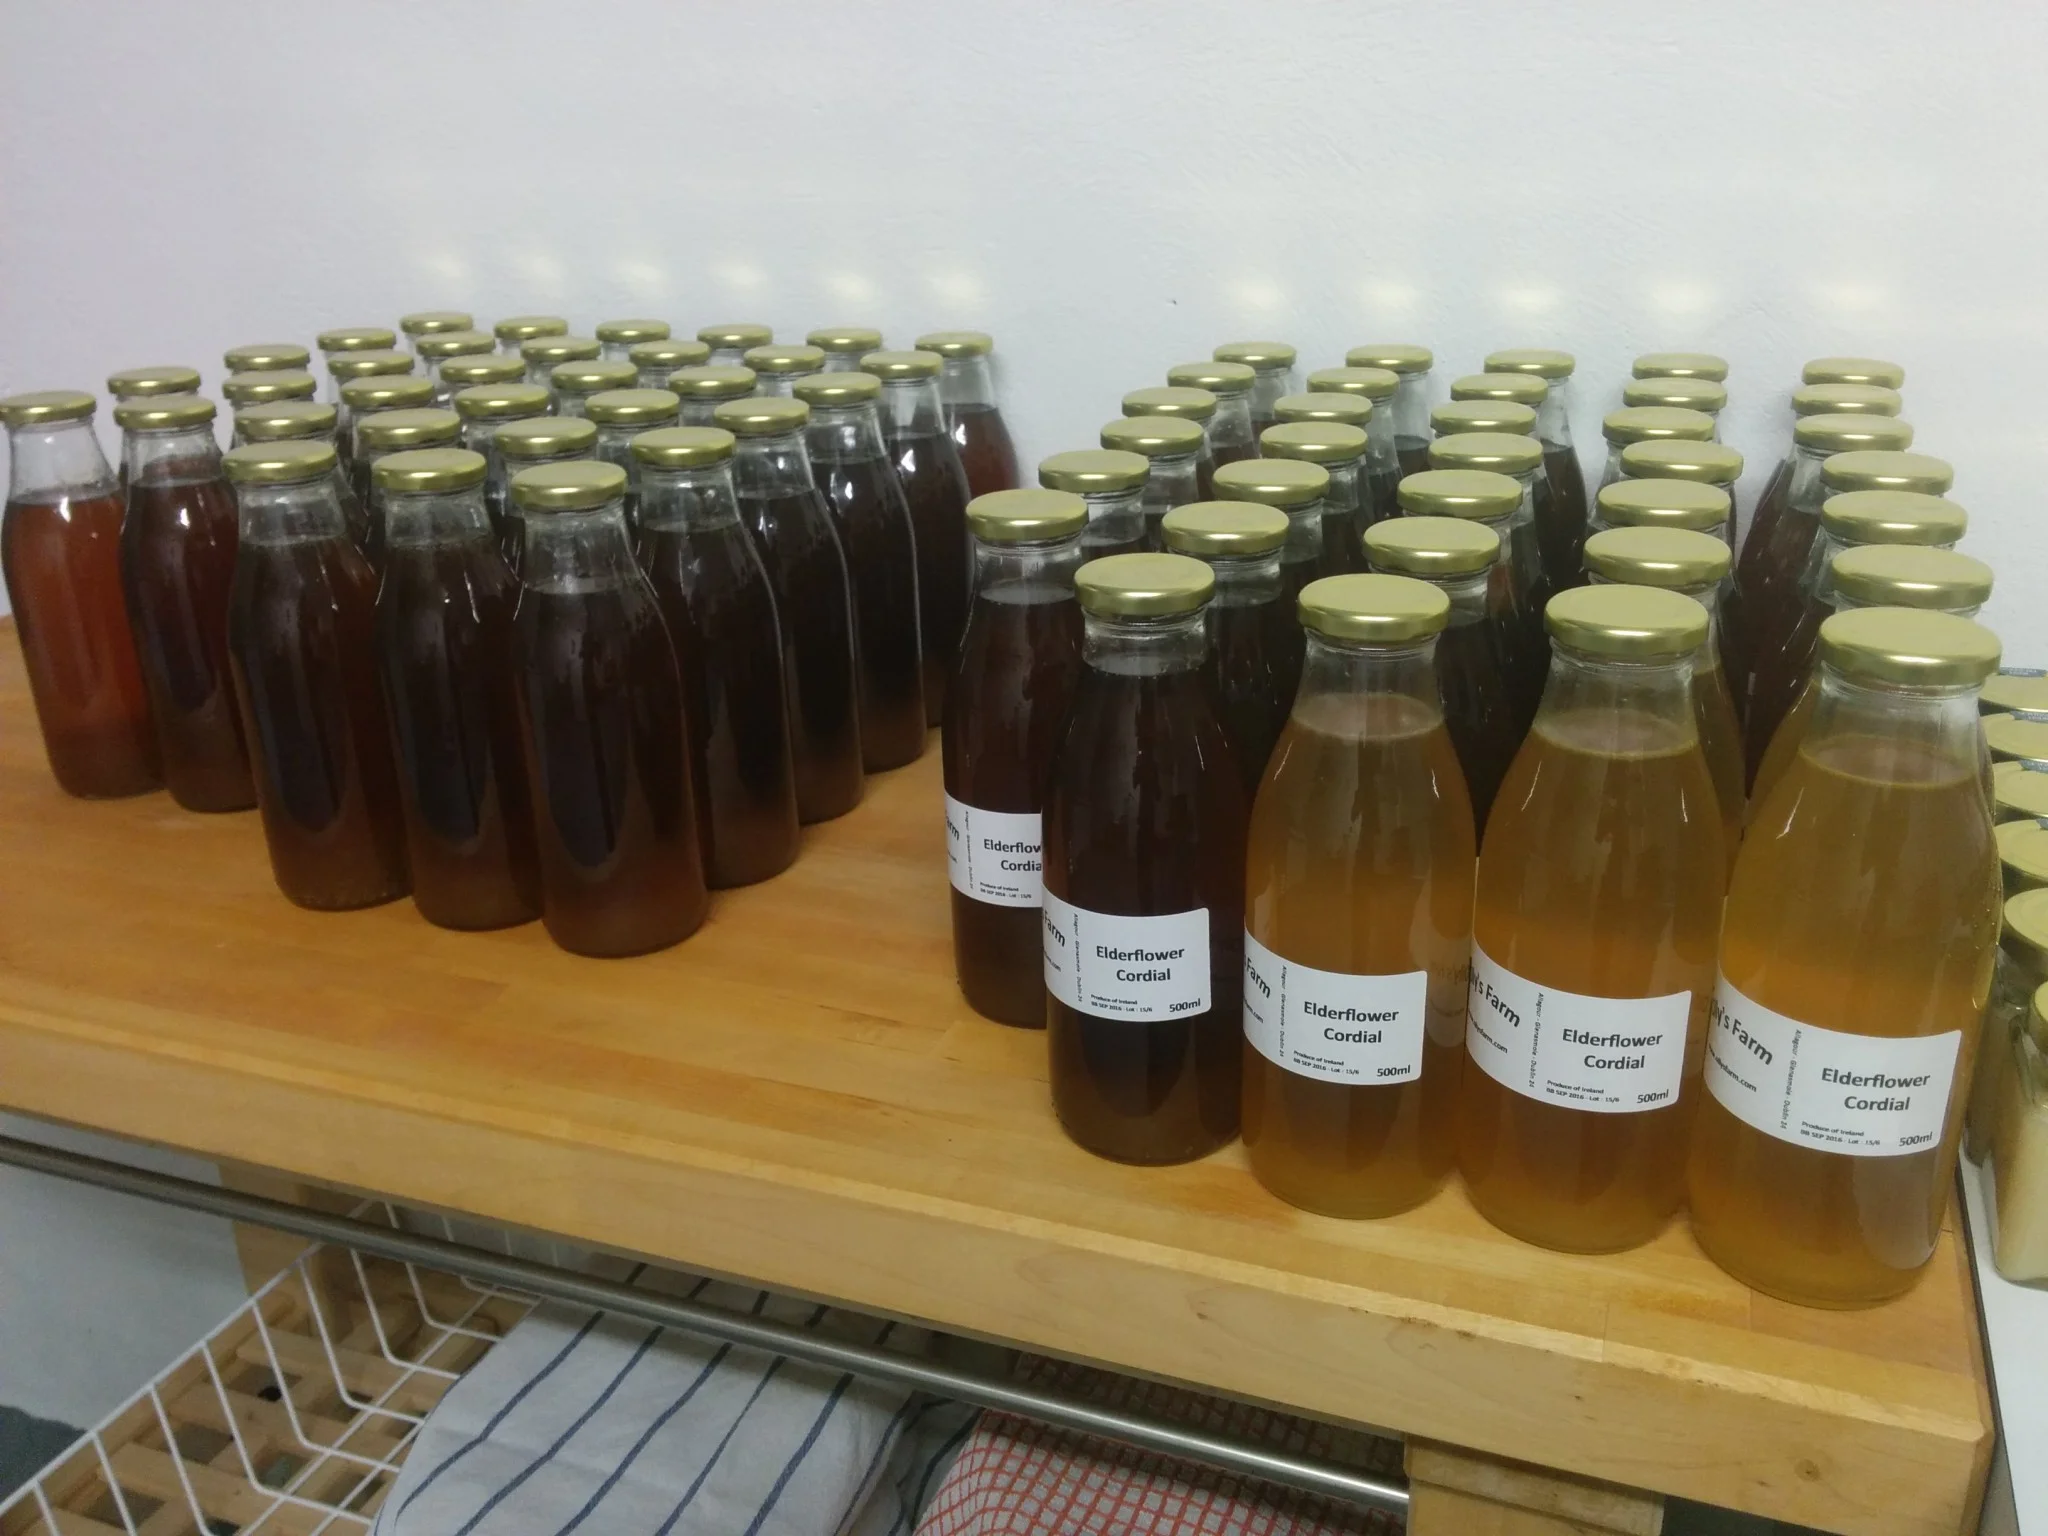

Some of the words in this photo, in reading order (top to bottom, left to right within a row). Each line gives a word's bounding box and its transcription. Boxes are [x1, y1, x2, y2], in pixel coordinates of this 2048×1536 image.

[1096, 946, 1185, 961] Elderflower
[1116, 969, 1171, 982] Cordial
[1246, 957, 1271, 999] Farm
[1169, 999, 1201, 1012] 500ml
[1304, 1002, 1399, 1022] Elderflower
[1486, 984, 1520, 1027] Farm
[1324, 1028, 1382, 1043] Cordial
[1563, 1028, 1663, 1047] Elderflower
[1732, 1019, 1773, 1065] Farm
[1294, 1050, 1315, 1060] Produce
[1584, 1055, 1645, 1069] Cordial
[1377, 1065, 1410, 1077] 500ml
[1821, 1067, 1931, 1089] Elderflower
[1547, 1080, 1572, 1090] Produce
[1637, 1090, 1669, 1104] 500ml
[1844, 1096, 1910, 1111] Cordial
[1802, 1121, 1829, 1132] Produce
[1899, 1132, 1932, 1147] 500ml
